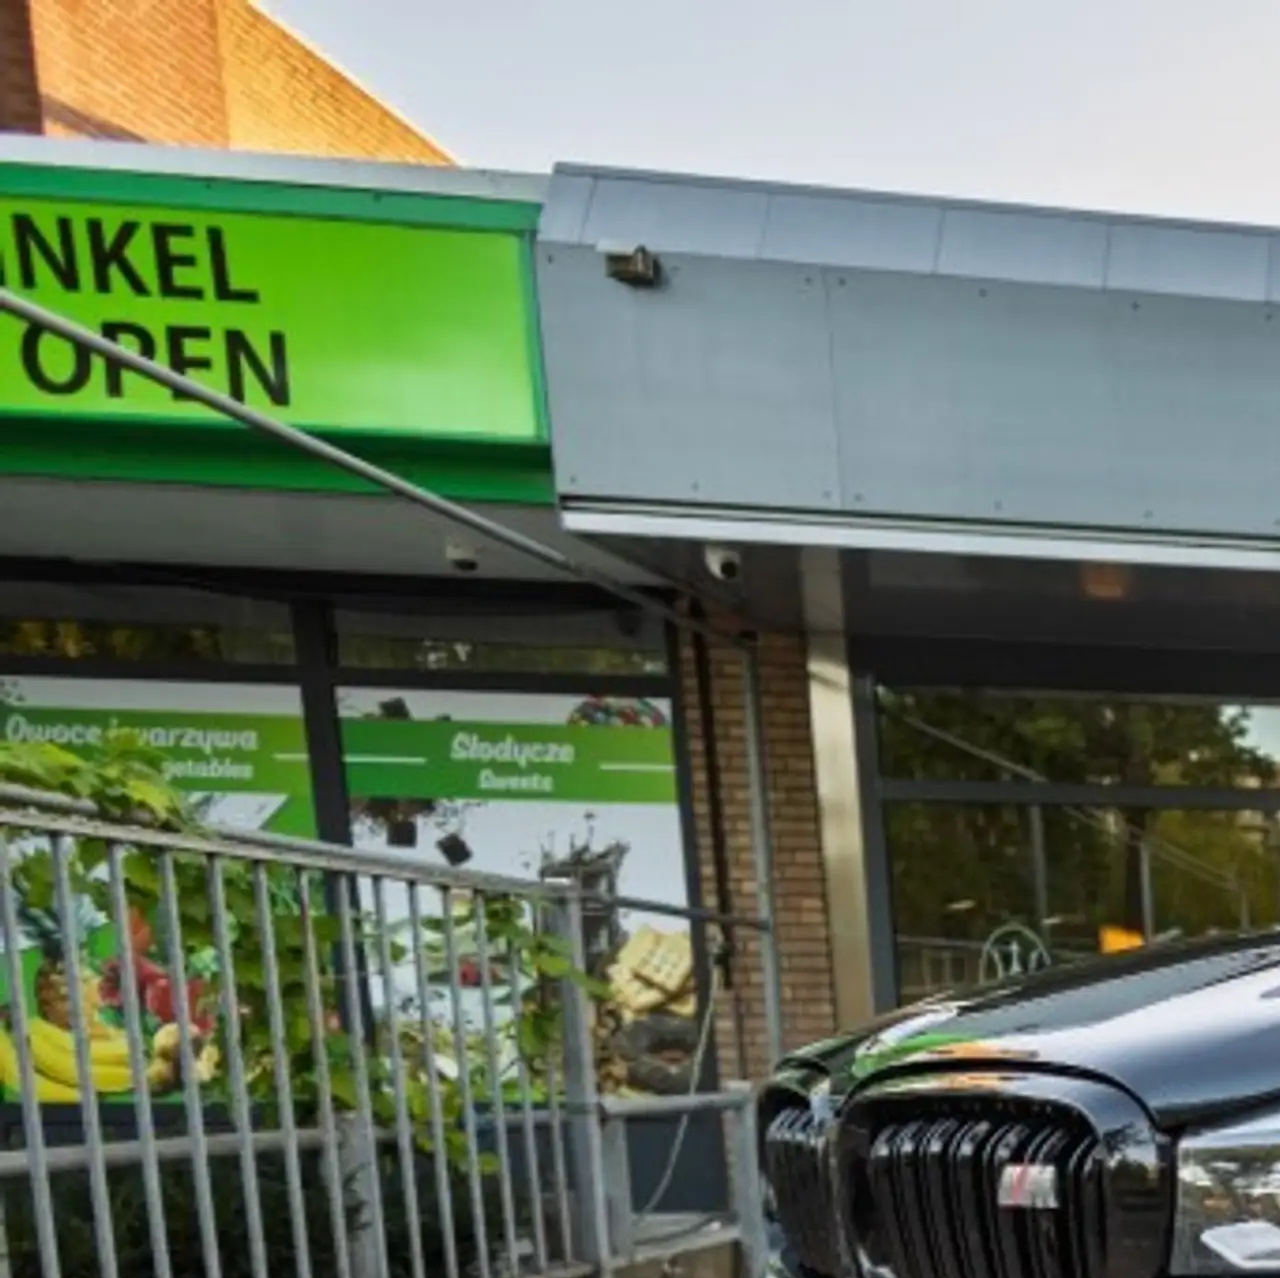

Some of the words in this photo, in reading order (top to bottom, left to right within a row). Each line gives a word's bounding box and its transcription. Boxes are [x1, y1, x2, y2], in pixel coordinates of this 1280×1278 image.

[0, 213, 260, 303] NKEL
[20, 319, 291, 407] OPEN
[6, 714, 103, 746] Owoce
